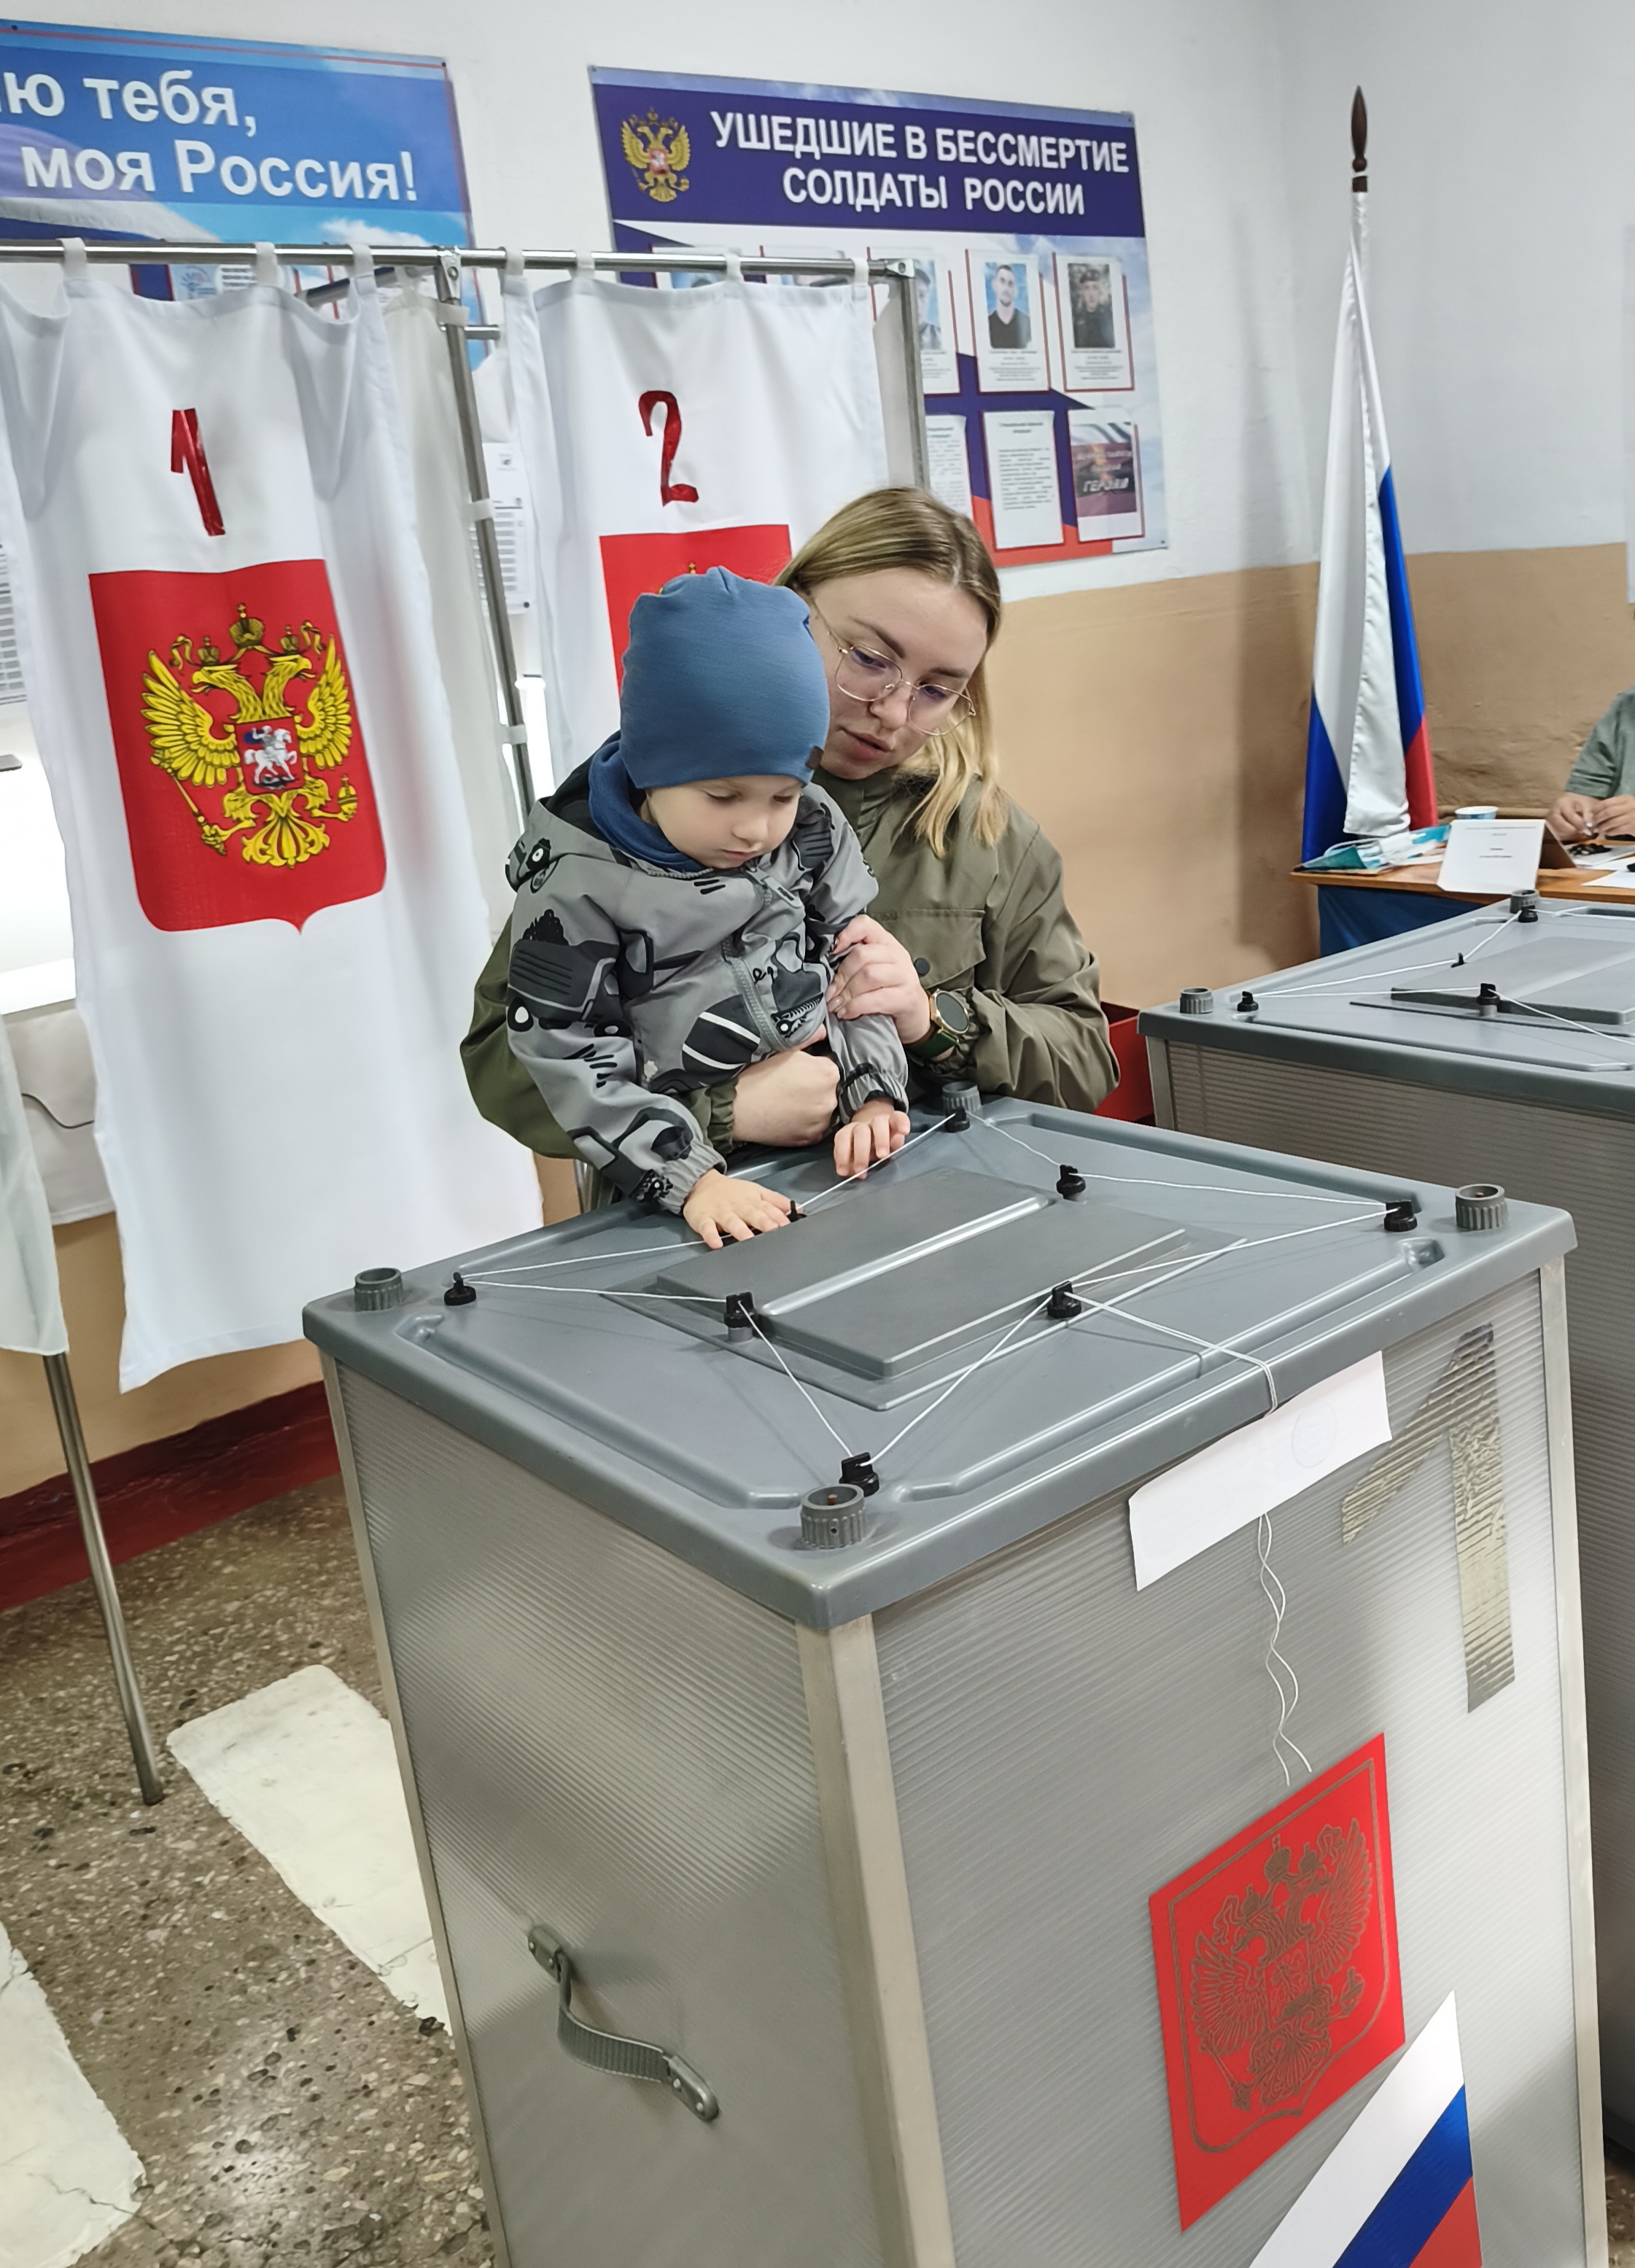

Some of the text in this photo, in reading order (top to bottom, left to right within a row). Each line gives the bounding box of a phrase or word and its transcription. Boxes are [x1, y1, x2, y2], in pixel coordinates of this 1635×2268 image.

[0, 69, 257, 137] ю тебя,
[20, 139, 418, 201] моя Россия!
[710, 110, 1130, 173] УШЕДШИЕ В БЕССМЕРТИЕ
[782, 167, 1085, 215] СОЛДАТЫ РОССИИ
[171, 408, 226, 537] 1
[638, 390, 699, 508] 2
